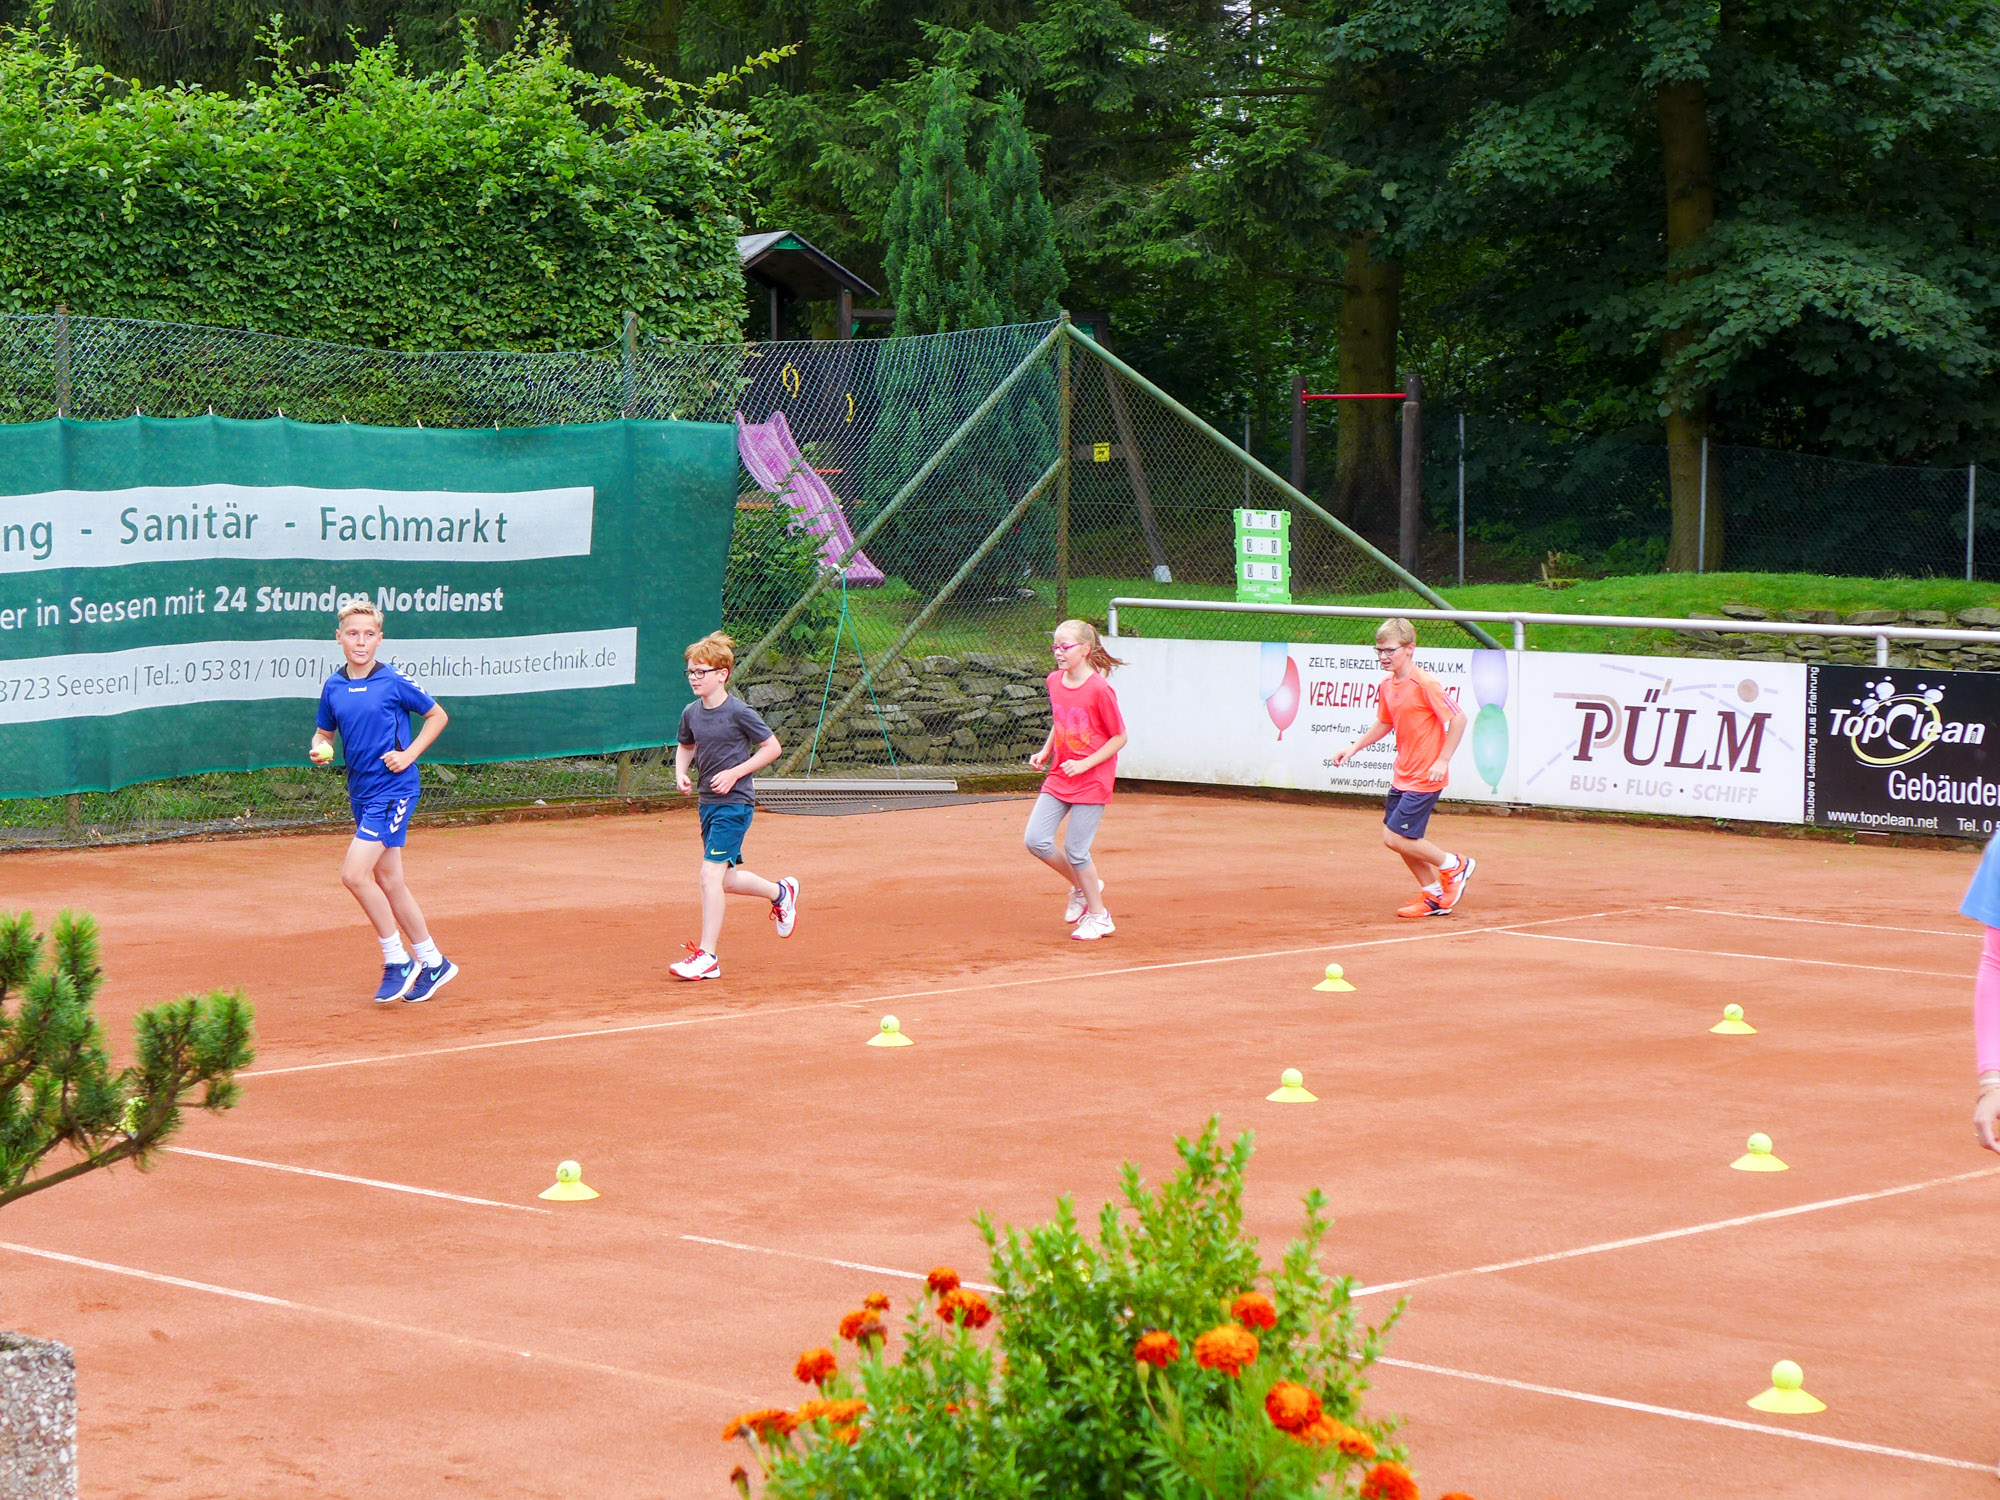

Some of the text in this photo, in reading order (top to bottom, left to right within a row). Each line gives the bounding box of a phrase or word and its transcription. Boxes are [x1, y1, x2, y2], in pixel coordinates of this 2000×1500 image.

[3, 521, 52, 560] ng
[120, 502, 258, 544] Sanitär
[320, 504, 508, 543] Fachmarkt
[36, 599, 60, 627] in
[69, 596, 157, 624] Seesen
[164, 587, 206, 616] mit
[213, 586, 248, 612] 24
[376, 585, 504, 612] Notdienst
[57, 675, 129, 697] Seesen
[144, 664, 179, 687] Tel.:
[185, 662, 196, 683] 0
[1309, 657, 1338, 670] ZELTE,
[1309, 682, 1363, 707] VERLEIH
[1311, 723, 1350, 734] sport+fun
[1573, 688, 1772, 773] PÜLM
[1806, 666, 1820, 822] Saubere Leistung aus Erfahrung
[1569, 775, 1759, 804] BUS FLUG SCHIFF
[1827, 810, 1939, 829] www.topclean.net
[1956, 817, 1980, 832] Tel.
[1983, 819, 1993, 833] 0
